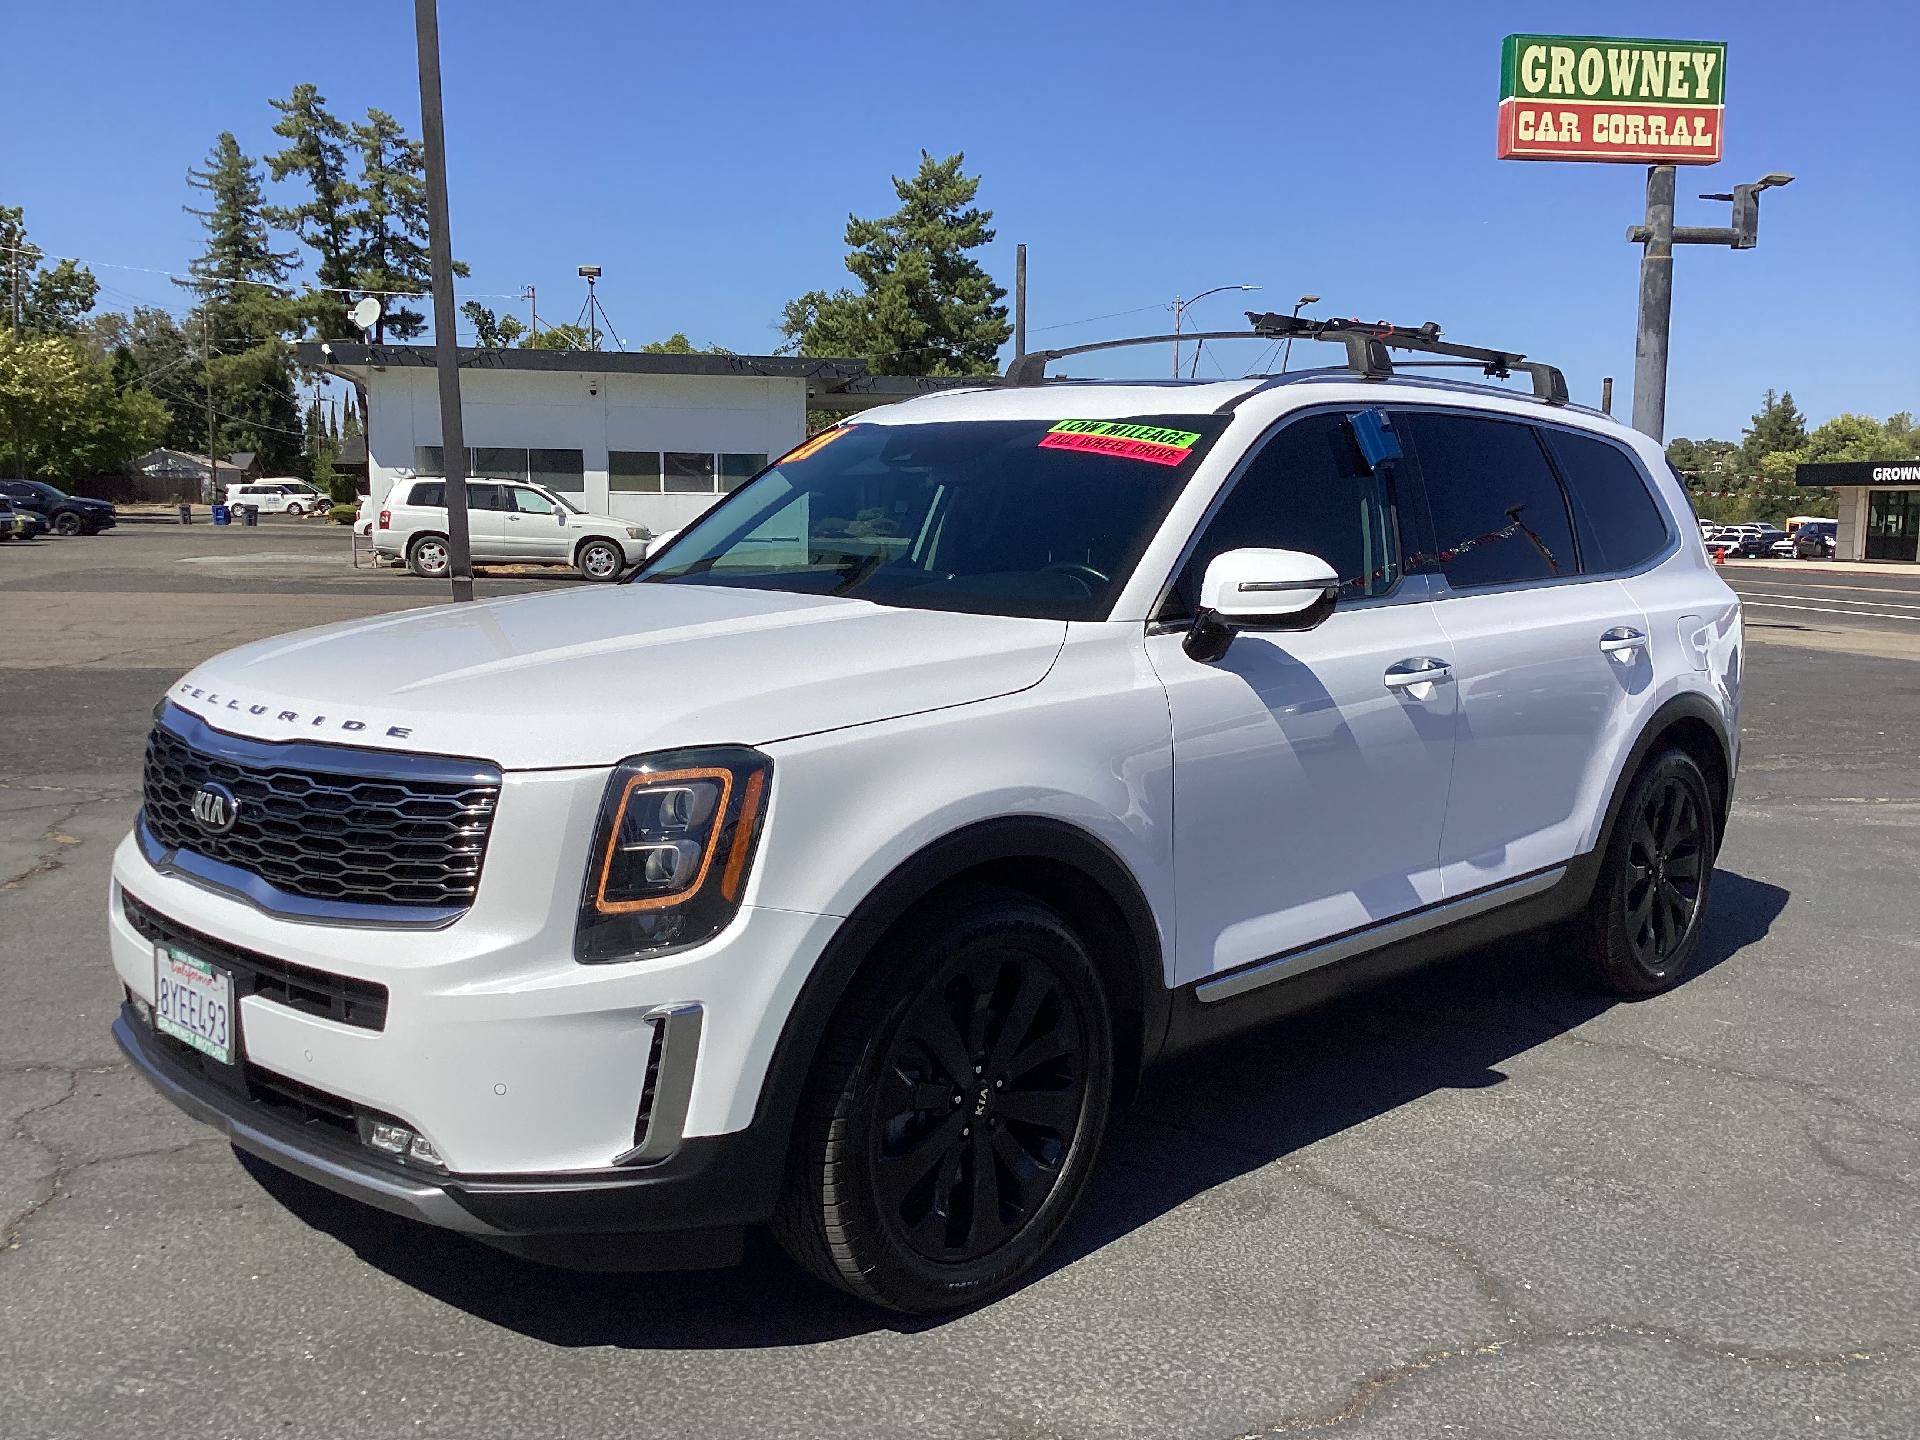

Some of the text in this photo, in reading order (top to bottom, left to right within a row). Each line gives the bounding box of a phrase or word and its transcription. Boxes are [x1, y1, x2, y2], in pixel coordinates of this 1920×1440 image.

[1521, 44, 1716, 98] GROWNEY
[1518, 111, 1712, 147] CAR CORRAL
[1056, 420, 1191, 445] LOW MILEAGE
[1078, 436, 1128, 451] WHEEL
[1873, 466, 1920, 481] GROWN
[180, 683, 413, 739] TELLURIDE
[194, 790, 225, 825] KIA
[160, 977, 227, 1045] 8YEE493
[974, 1088, 989, 1116] KIA
